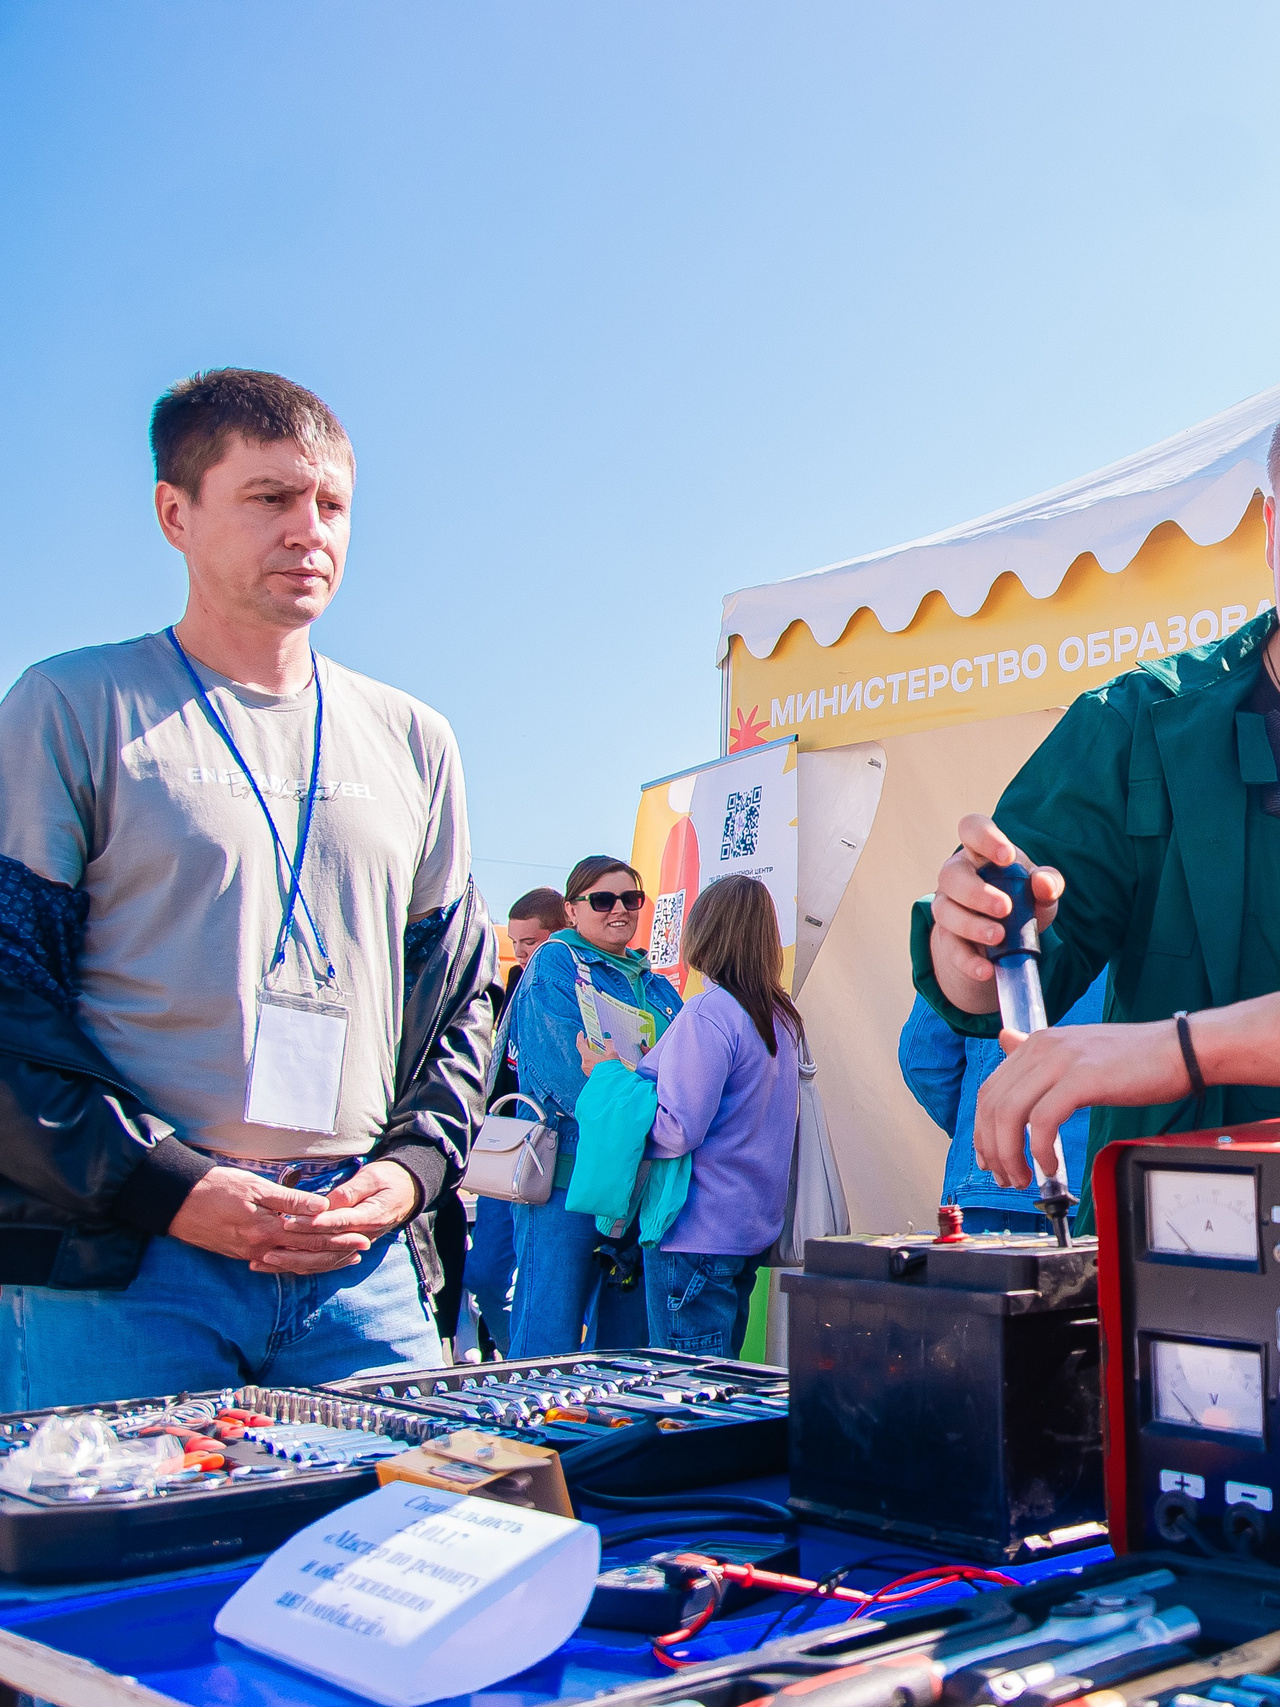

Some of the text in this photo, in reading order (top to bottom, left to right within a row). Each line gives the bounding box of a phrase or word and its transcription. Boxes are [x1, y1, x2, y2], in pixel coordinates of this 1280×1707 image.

[770, 643, 1048, 728] МИНИСТЕРСТВО
[1205, 1220, 1214, 1232] A
[1208, 1392, 1219, 1407] V
[404, 1494, 525, 1535] Специальность
[299, 1558, 319, 1574] и
[386, 1551, 413, 1568] по
[401, 1557, 481, 1595] ремонту
